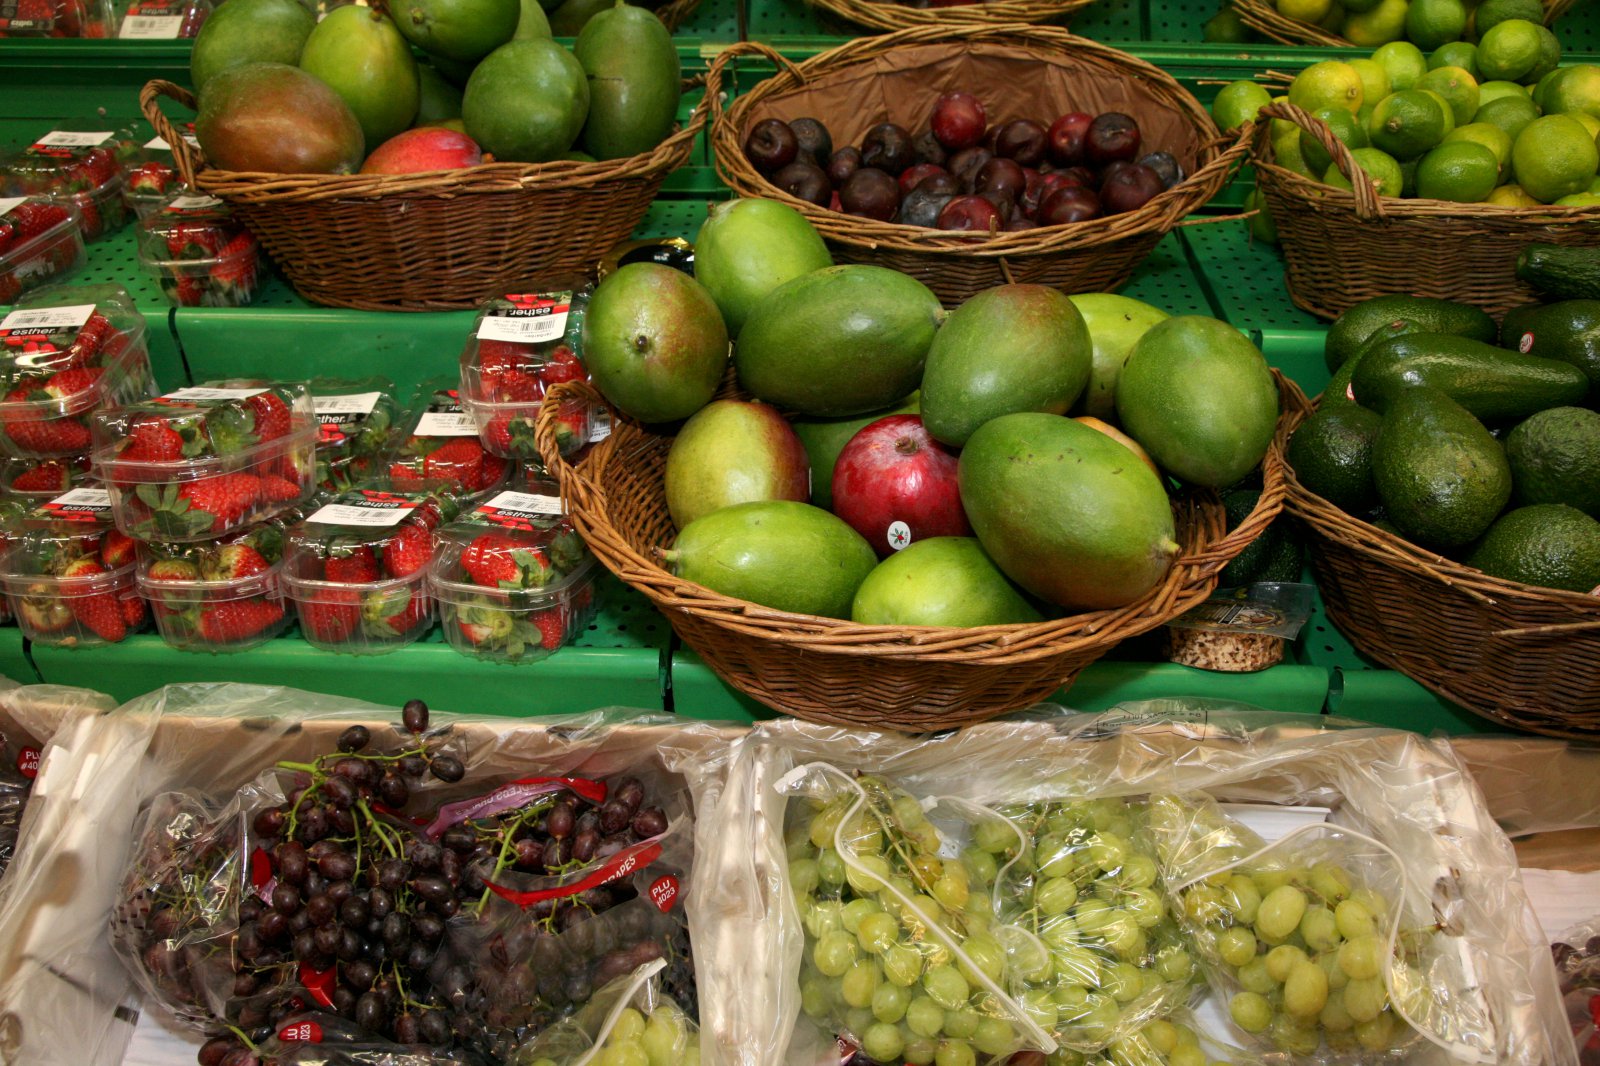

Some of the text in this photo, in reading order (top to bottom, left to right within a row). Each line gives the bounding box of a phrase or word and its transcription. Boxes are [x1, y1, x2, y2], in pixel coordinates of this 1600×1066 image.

[20, 761, 38, 770] #40
[652, 879, 671, 898] PLU
[287, 1028, 298, 1040] LU
[300, 1024, 311, 1040] 023
